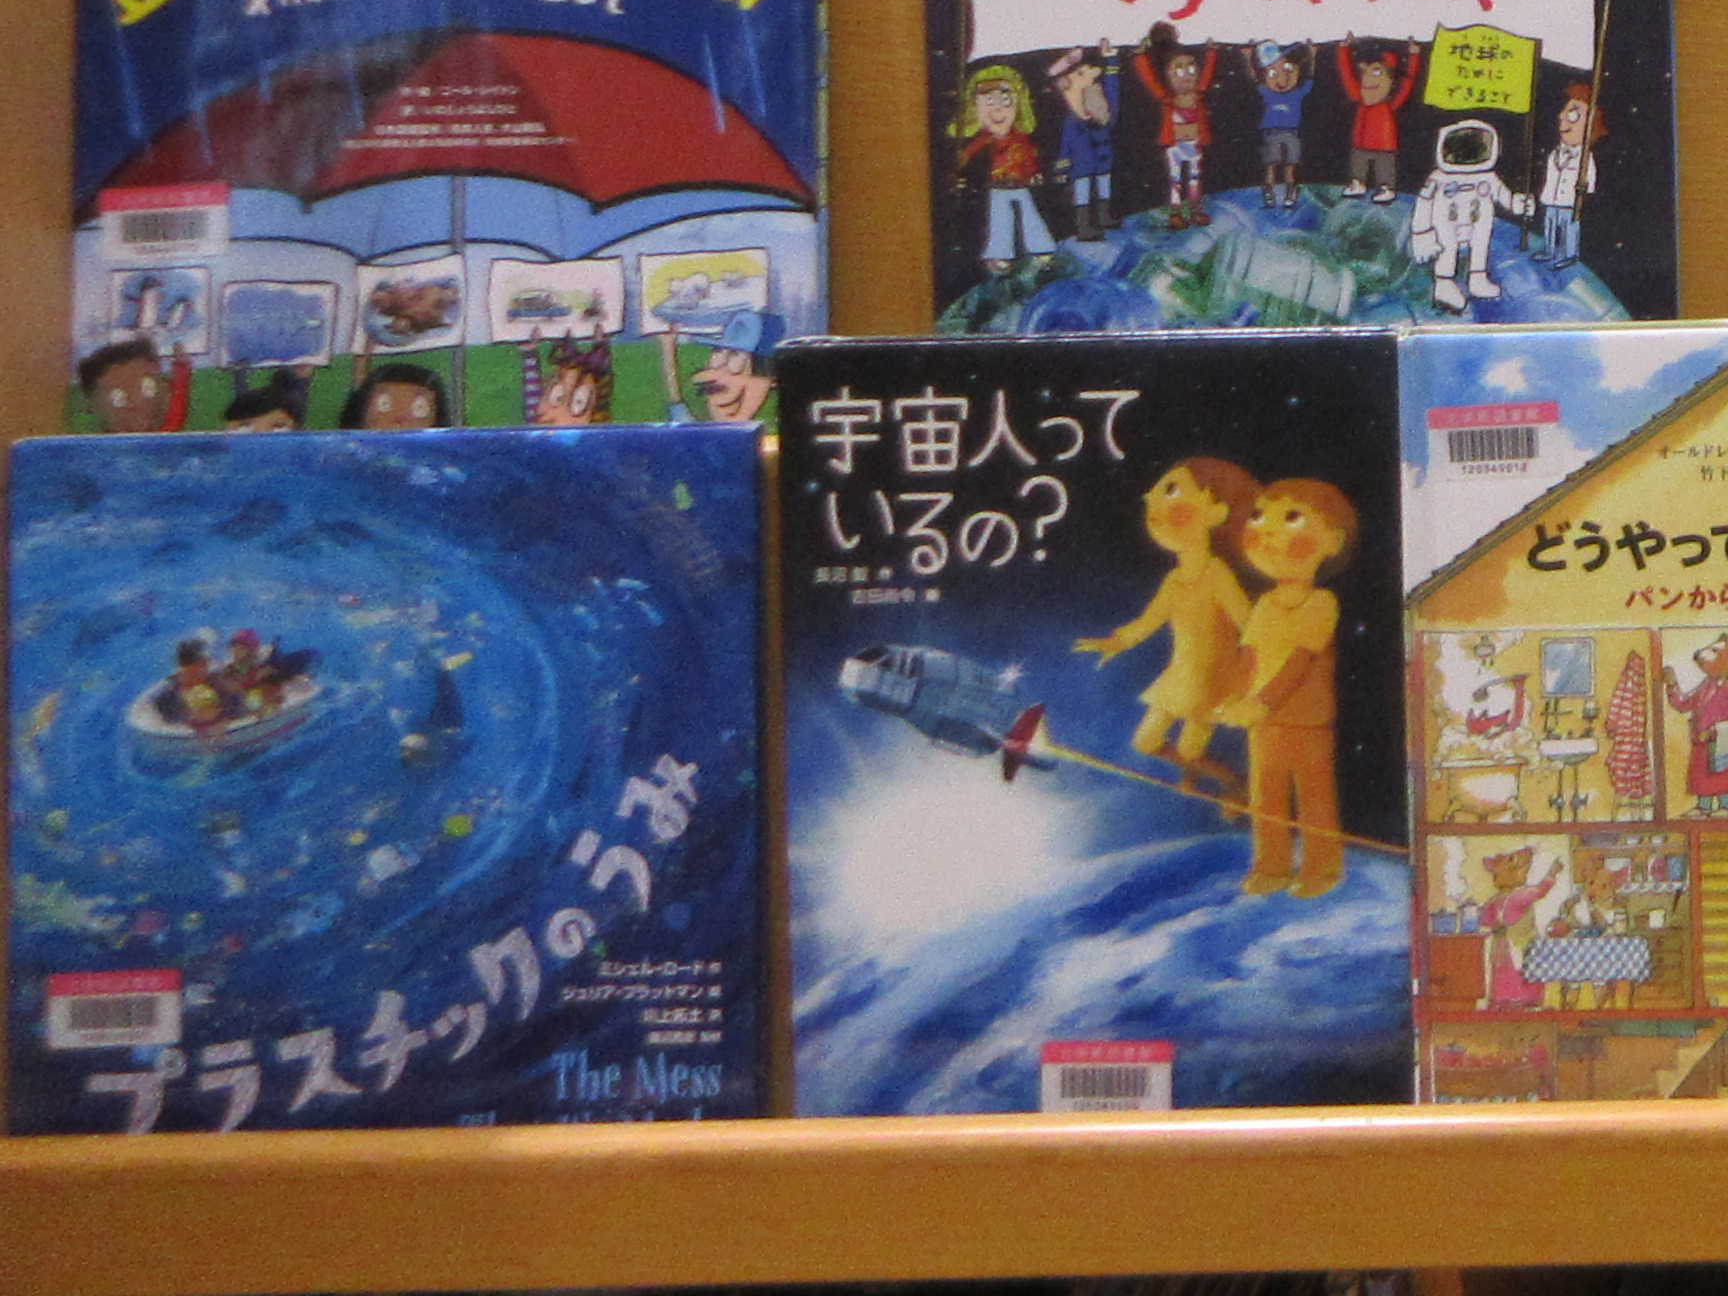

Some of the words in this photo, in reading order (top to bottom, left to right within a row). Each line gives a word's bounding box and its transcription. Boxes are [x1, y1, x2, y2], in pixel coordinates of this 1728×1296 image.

[1449, 43, 1513, 62] 地球の
[809, 384, 1142, 478] 宇宙人って
[826, 474, 1070, 575] いるの?
[84, 752, 701, 1136] プラスチックのうみ
[550, 1048, 623, 1102] The
[632, 1051, 724, 1104] Mess
